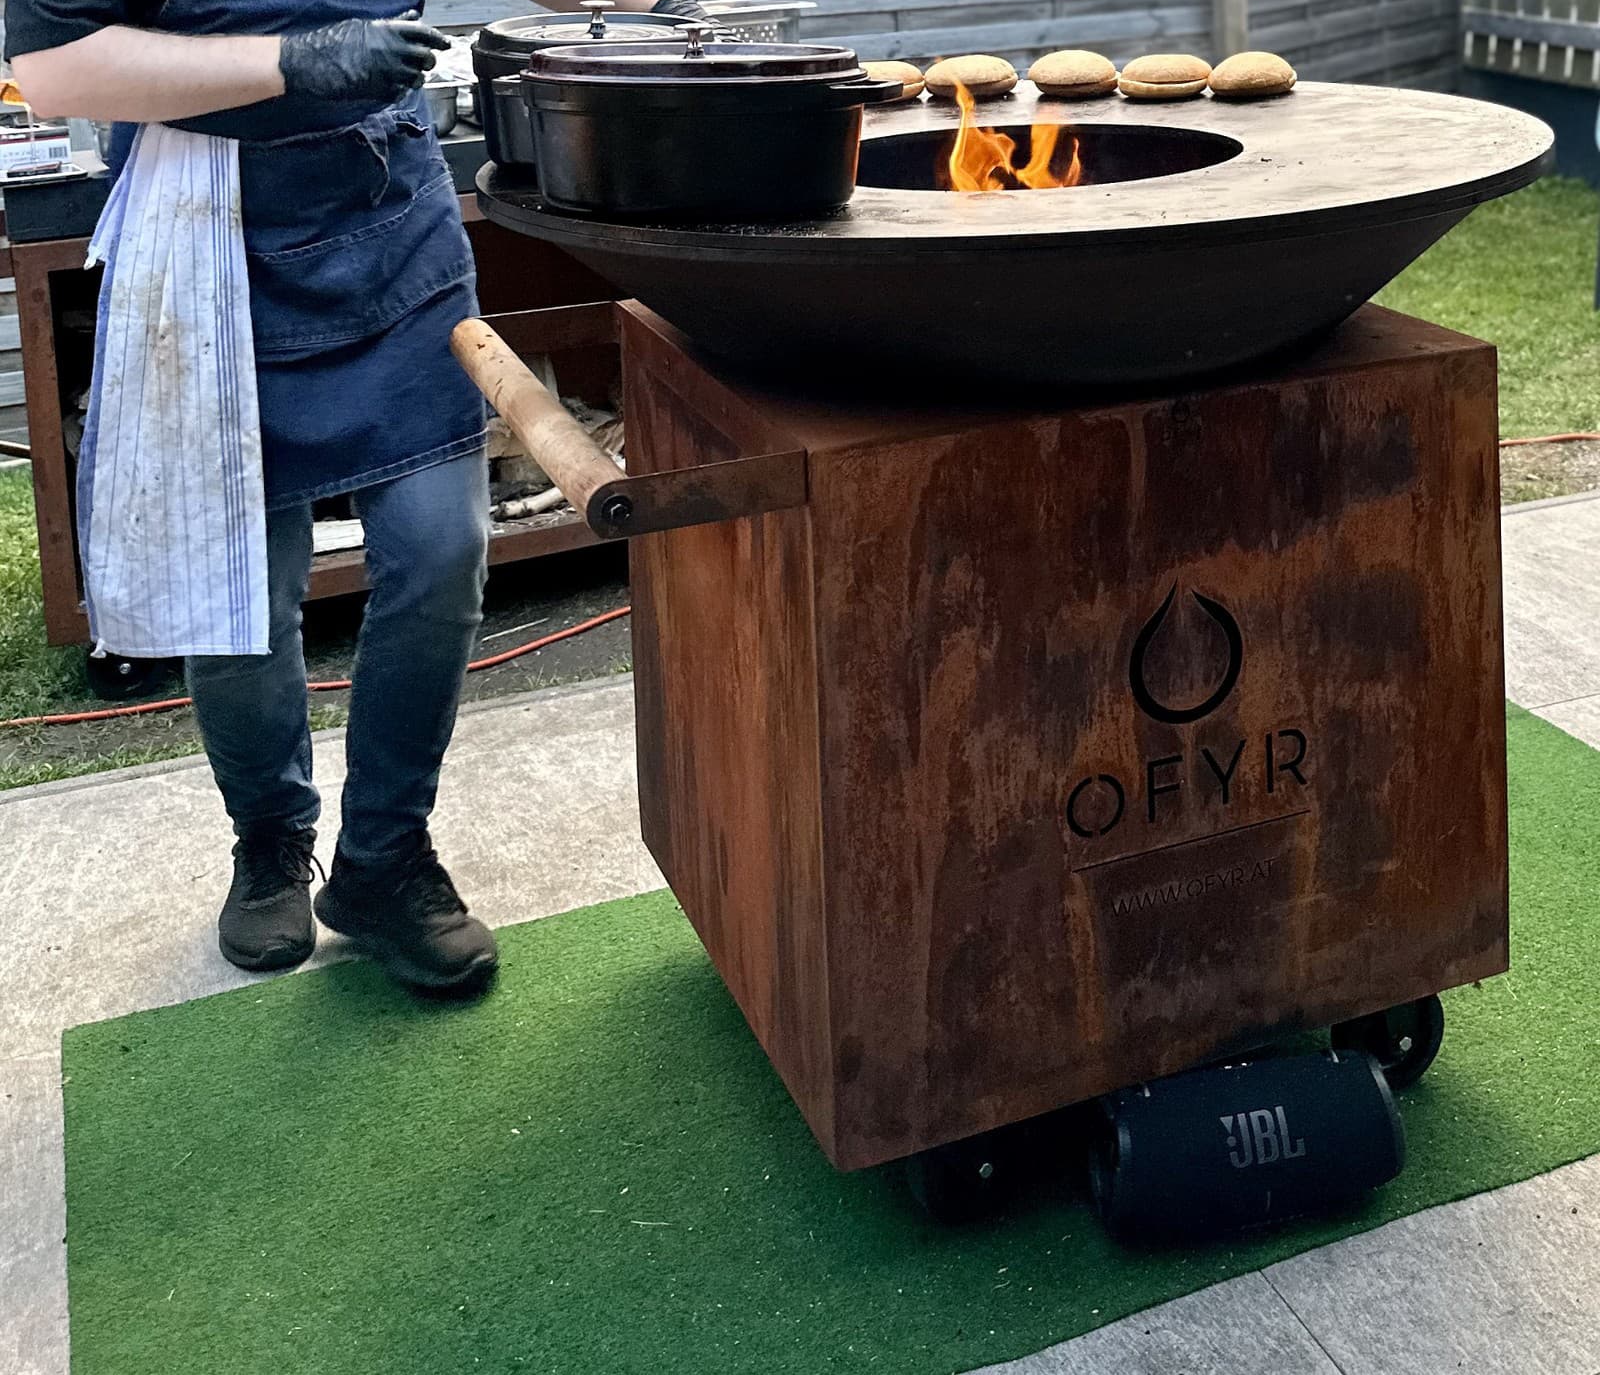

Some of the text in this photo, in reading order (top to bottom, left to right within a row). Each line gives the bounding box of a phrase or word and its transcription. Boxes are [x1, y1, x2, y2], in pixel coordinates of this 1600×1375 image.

[1066, 729, 1308, 838] OFYR
[1110, 858, 1276, 917] WWWOFYR.AT
[1221, 1105, 1306, 1168] JBL
